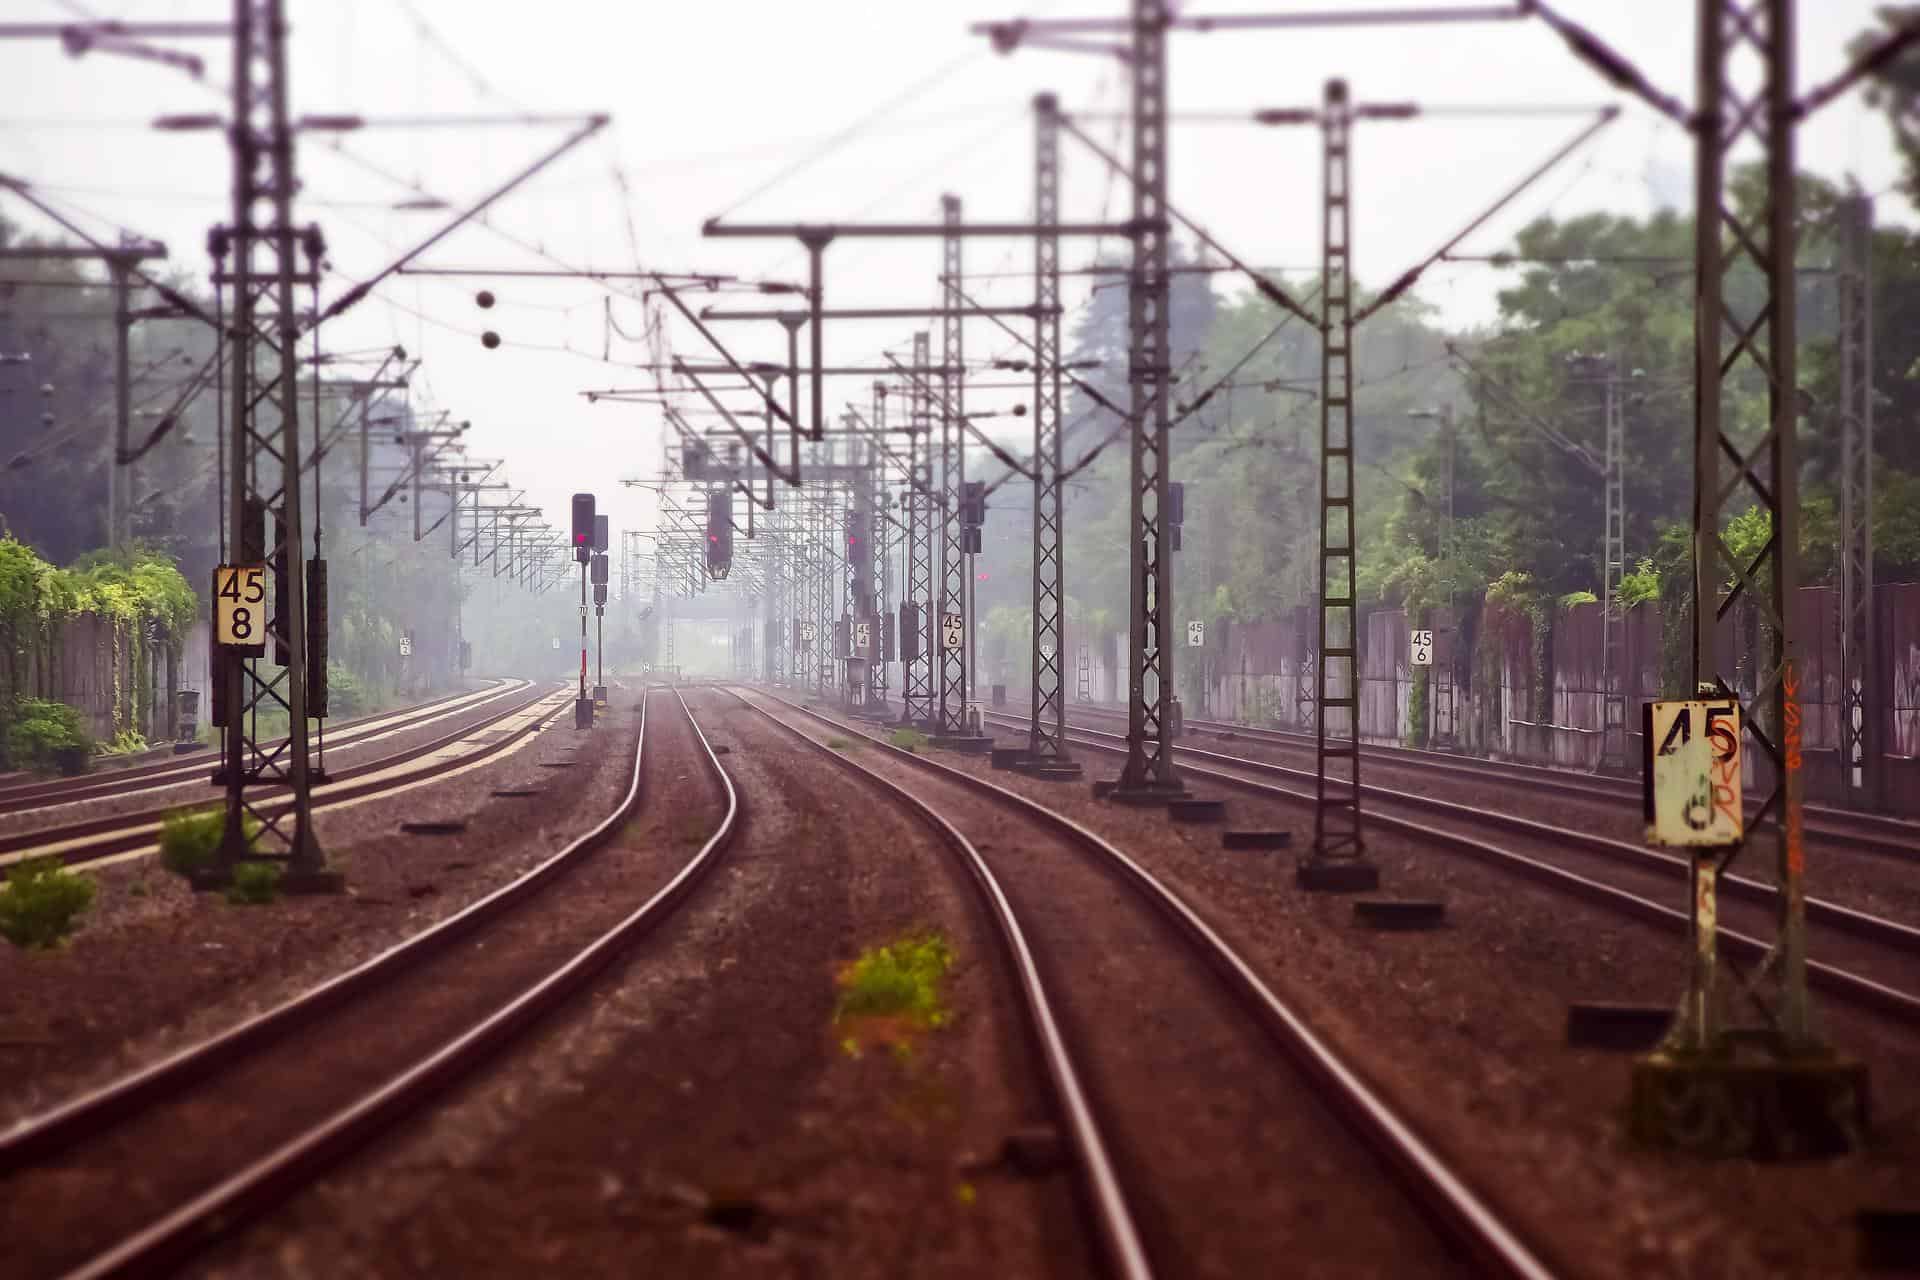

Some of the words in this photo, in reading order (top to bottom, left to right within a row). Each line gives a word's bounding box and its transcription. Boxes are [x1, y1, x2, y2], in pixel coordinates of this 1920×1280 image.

[220, 568, 265, 604] 45
[231, 607, 252, 639] 8
[943, 615, 962, 630] 45
[1190, 623, 1203, 633] 45
[948, 630, 958, 645] 6
[1192, 634, 1200, 644] 4
[1412, 631, 1432, 647] 45
[1417, 647, 1427, 662] 6
[1657, 707, 1738, 763] 45
